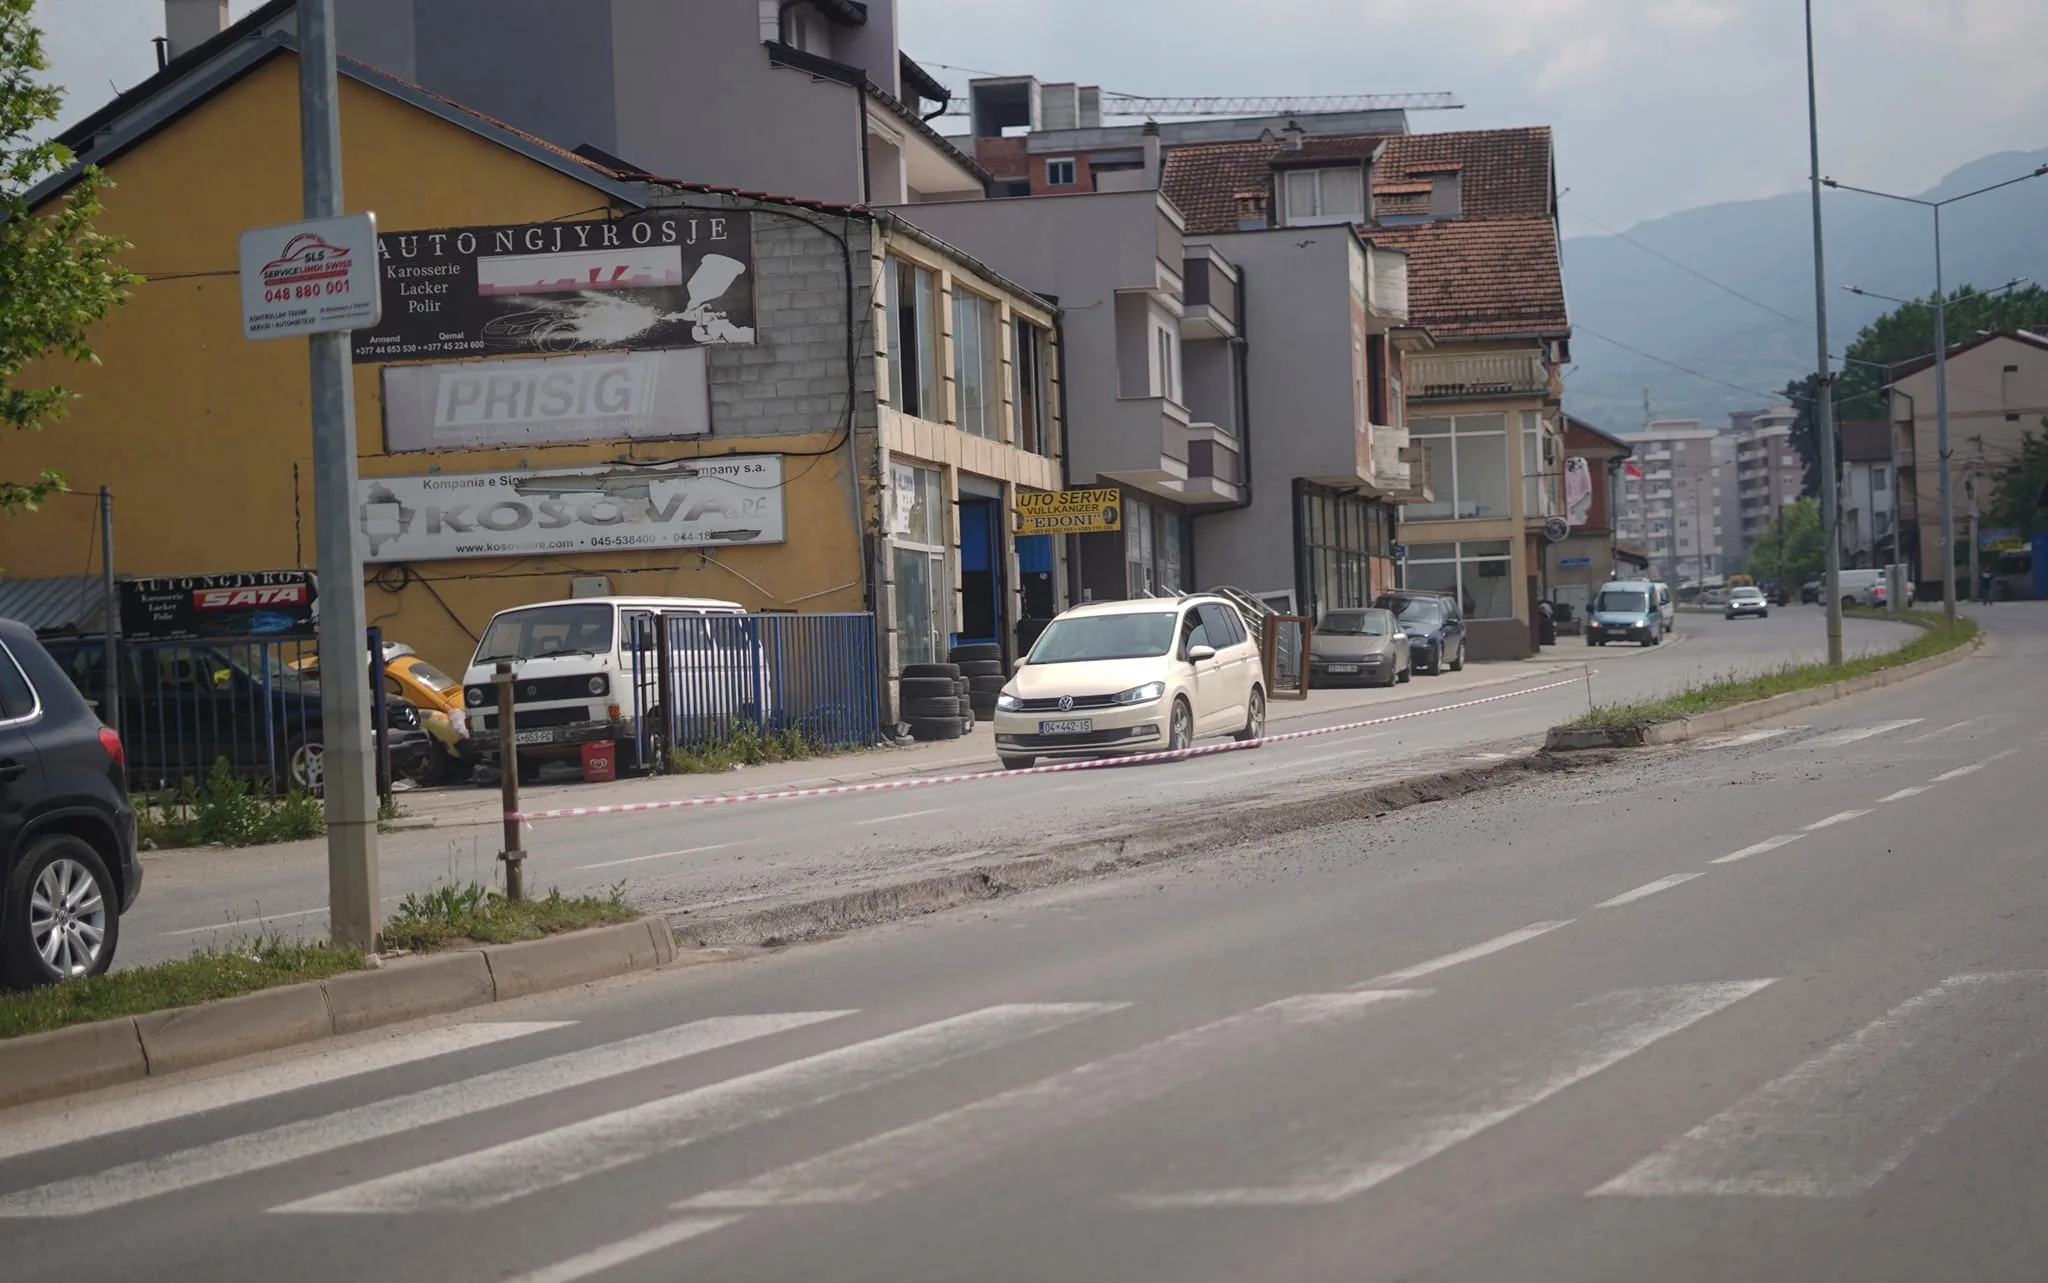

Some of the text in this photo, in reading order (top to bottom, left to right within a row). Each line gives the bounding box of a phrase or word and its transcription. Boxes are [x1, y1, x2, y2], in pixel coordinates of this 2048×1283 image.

[376, 218, 728, 259] AUTO NGJYROSJE
[304, 251, 325, 263] SLS
[263, 267, 299, 280] SERVICE
[325, 259, 352, 272] SWISS
[387, 263, 461, 279] Karosserie
[265, 280, 350, 303] 048 880 001
[400, 281, 448, 296] Lacker
[408, 299, 442, 313] Polir
[369, 332, 465, 344] Armend Qemal
[356, 346, 374, 356] +377
[402, 344, 417, 353] 530
[423, 343, 441, 352] +377
[443, 342, 453, 351] 45
[454, 341, 469, 350] 224
[446, 367, 632, 422] PRISIG
[423, 478, 485, 490] Kompania
[488, 478, 496, 487] e
[698, 465, 740, 476] mpany
[743, 464, 766, 473] s.a.
[1058, 489, 1118, 505] SERVIS
[1026, 503, 1100, 515] VULLKANIZER
[673, 531, 712, 542] 044-18
[202, 588, 299, 607] SATA
